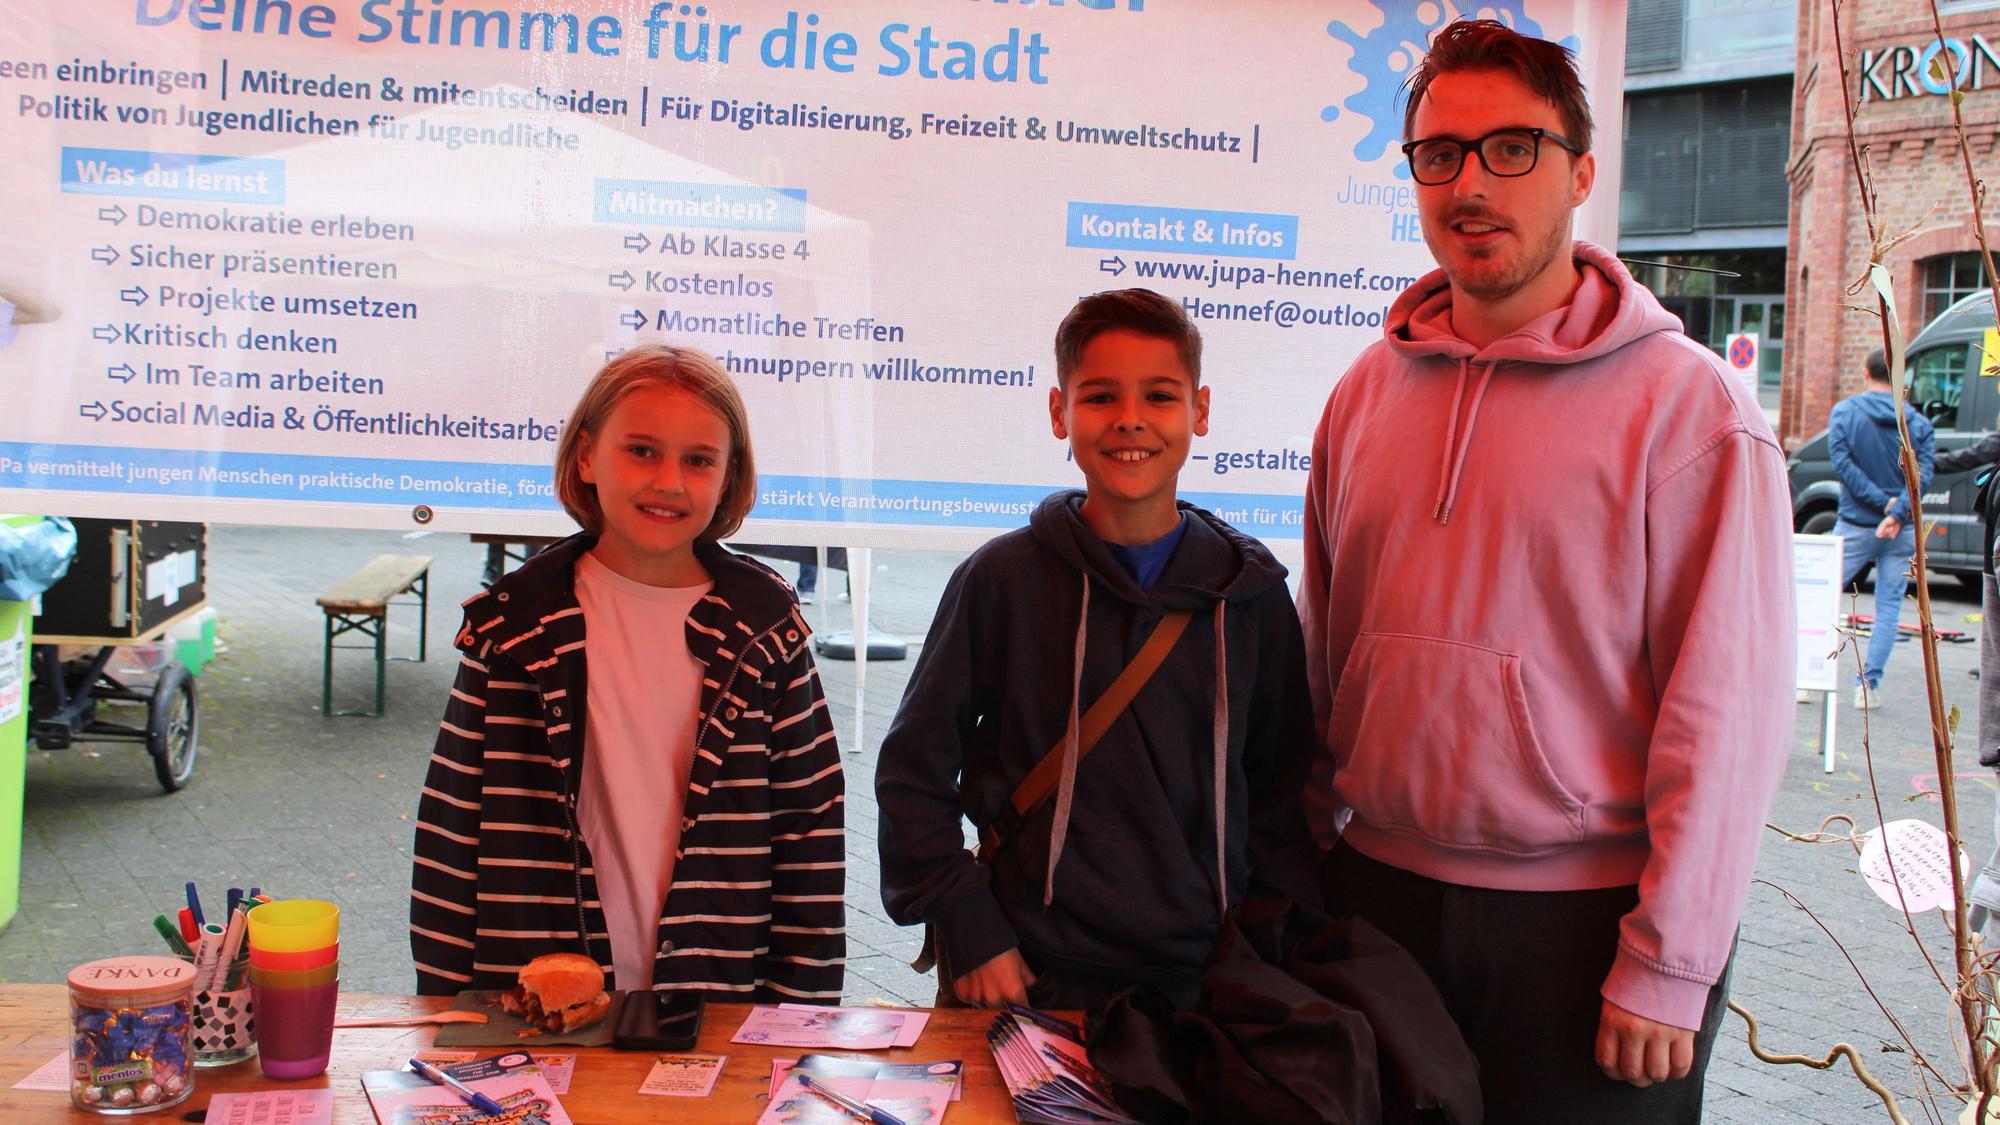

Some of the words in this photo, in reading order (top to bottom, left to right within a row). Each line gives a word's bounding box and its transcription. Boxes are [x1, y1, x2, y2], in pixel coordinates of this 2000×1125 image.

[358, 0, 622, 56] Stimme
[647, 2, 741, 64] für
[760, 11, 858, 74] die
[878, 23, 1050, 85] Stadt
[19, 94, 109, 123] Politik
[117, 104, 168, 126] von
[175, 104, 360, 138] Jugendlichen
[368, 114, 409, 138] für
[416, 120, 579, 151] Jugendliche
[56, 58, 208, 92] einbringen
[241, 70, 372, 101] Mitreden
[380, 78, 404, 102] &
[413, 80, 628, 117] mitentscheiden
[661, 95, 703, 121] Für
[711, 99, 912, 140] Digitalisierung,
[921, 111, 1018, 139] Freizeit
[1025, 115, 1048, 141] &
[1056, 120, 1241, 153] Umweltschutz
[76, 160, 135, 187] Was
[143, 164, 179, 188] du
[187, 165, 268, 194] lernst
[137, 203, 303, 238] Demokratie
[310, 210, 415, 241] erleben
[608, 189, 777, 221] Mitmachen?
[659, 232, 696, 257] Ab
[703, 235, 786, 261] Klasse
[793, 240, 811, 262] 4
[1081, 213, 1184, 242] Kontakt
[1192, 218, 1214, 244] &
[1222, 221, 1284, 248] Infos
[129, 245, 216, 274] Sicher
[222, 249, 398, 282] präsentieren
[1135, 260, 1417, 292] www.jupa-hennef.com
[645, 271, 774, 300] Kostenlos
[158, 286, 276, 319] Projekte
[284, 293, 418, 322] umsetzen
[123, 322, 227, 350] Kritisch
[236, 328, 338, 356] denken
[656, 310, 807, 340] Monatliche
[813, 317, 904, 345] Treffen
[145, 363, 180, 387] Im
[187, 365, 262, 391] Team
[269, 370, 385, 398] arbeiten
[862, 358, 1035, 390] willkommen!
[110, 400, 186, 426] Social
[193, 404, 276, 430] Media
[282, 408, 306, 432] &
[28, 460, 124, 480] vermittelt
[127, 462, 193, 485] jungen
[198, 466, 294, 487] Menschen
[299, 470, 395, 494] praktische
[399, 474, 513, 498] Demokratie,
[761, 491, 814, 509] stärkt
[819, 492, 1036, 517] Verantwortungsbewusst
[1214, 508, 1247, 525] Amt
[1252, 508, 1276, 525] für
[90, 967, 182, 979] DANKE
